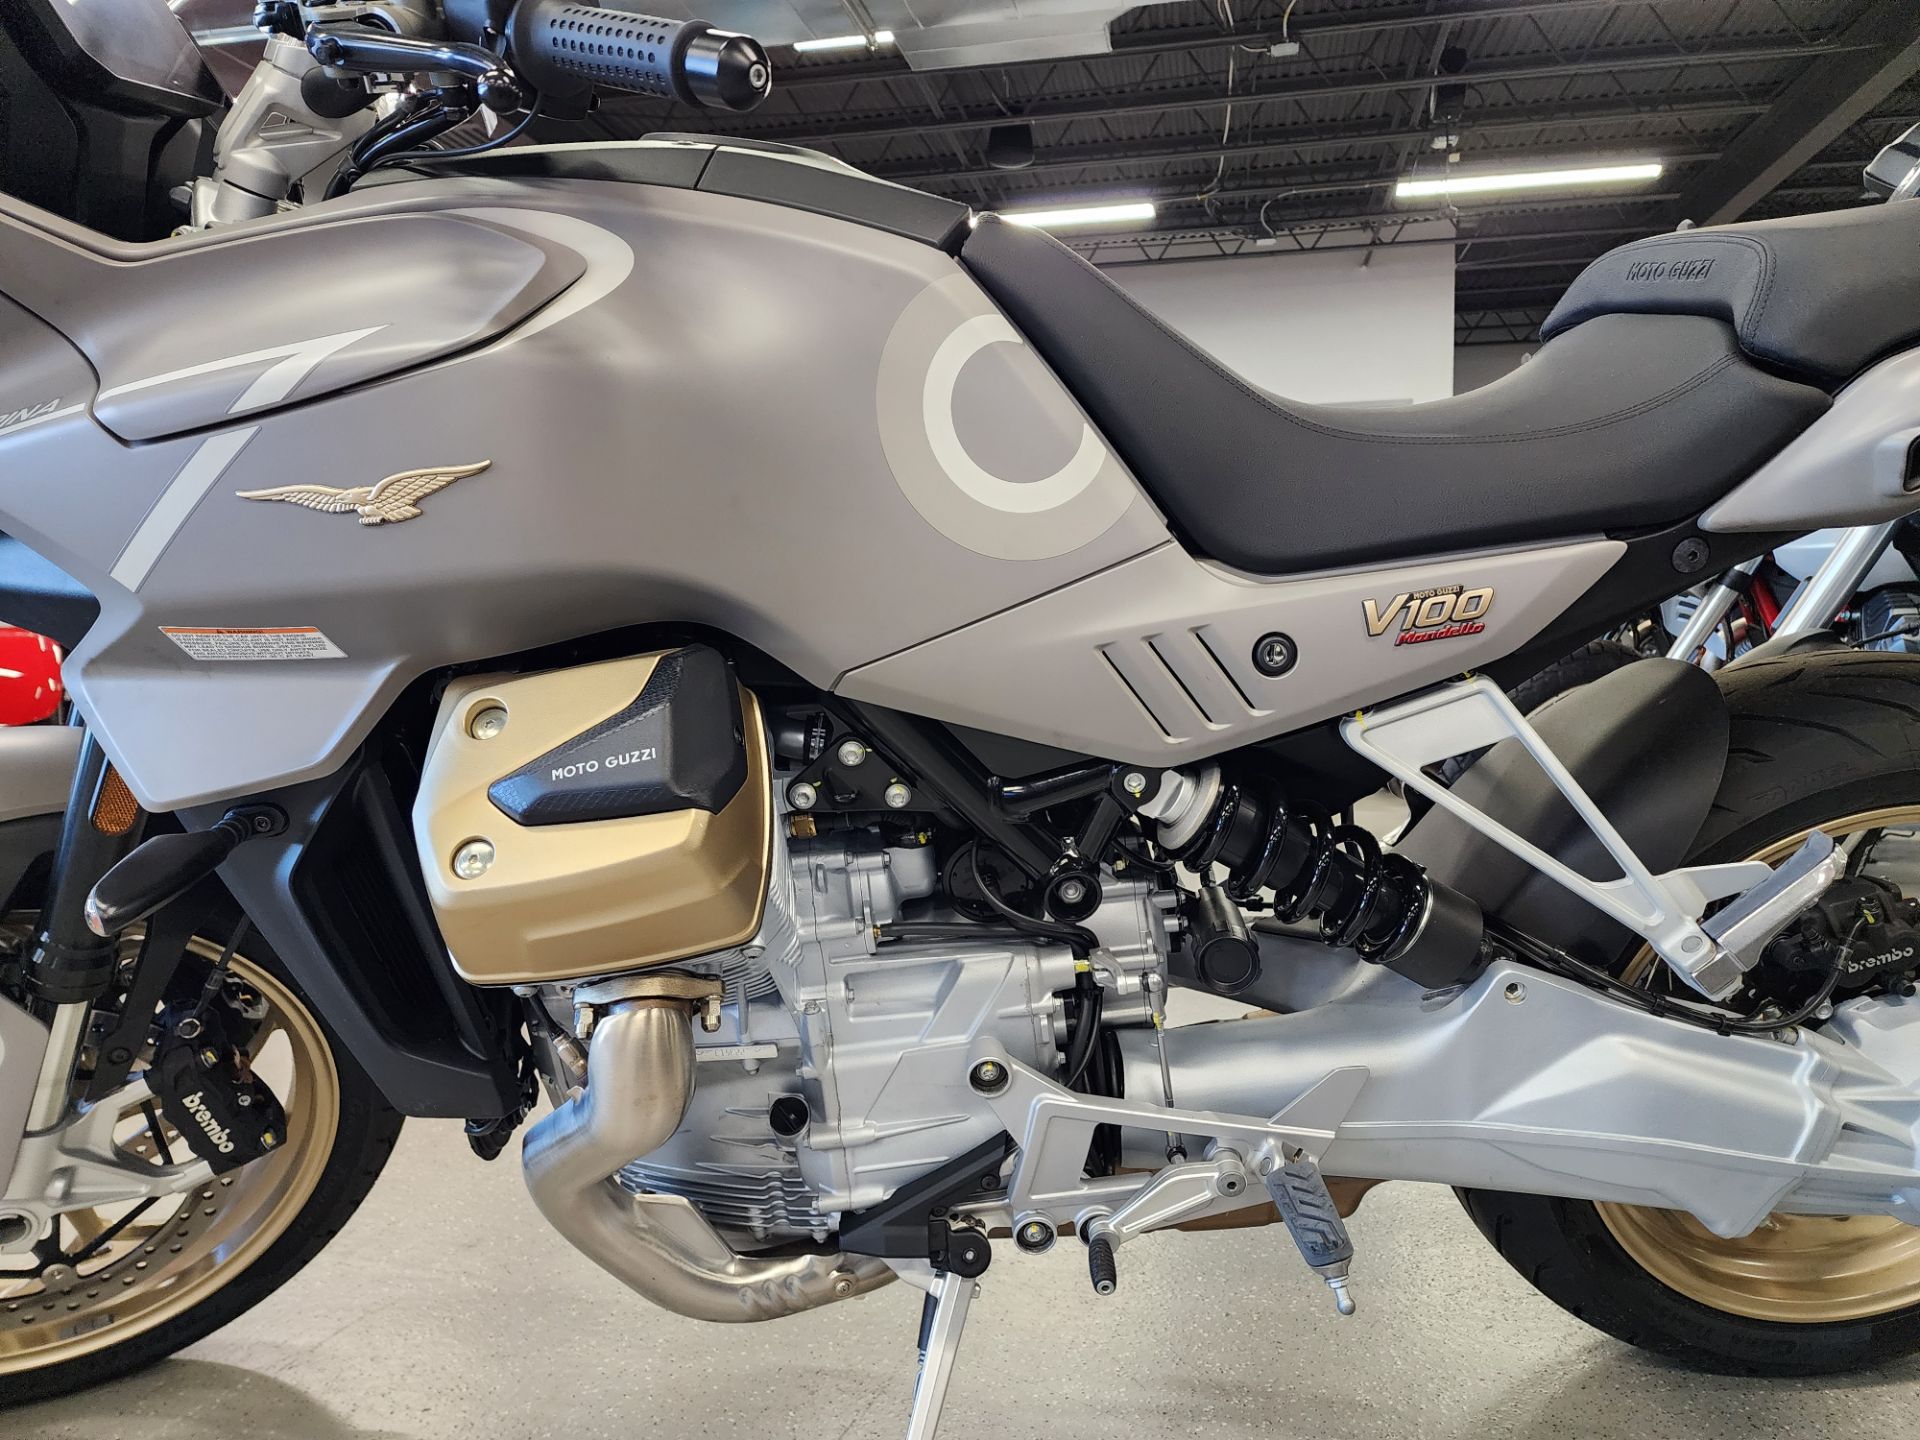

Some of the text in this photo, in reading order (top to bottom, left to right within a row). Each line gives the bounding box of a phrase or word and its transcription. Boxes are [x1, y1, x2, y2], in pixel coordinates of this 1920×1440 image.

[1626, 259, 1716, 281] MOTO GUZZI
[1413, 586, 1460, 600] MOTO GUZZI
[1361, 586, 1495, 637] V100
[1394, 621, 1486, 646] Mandello
[551, 747, 657, 781] MOTO GUZZI
[1848, 947, 1914, 974] brembo
[182, 1091, 235, 1153] brembo
